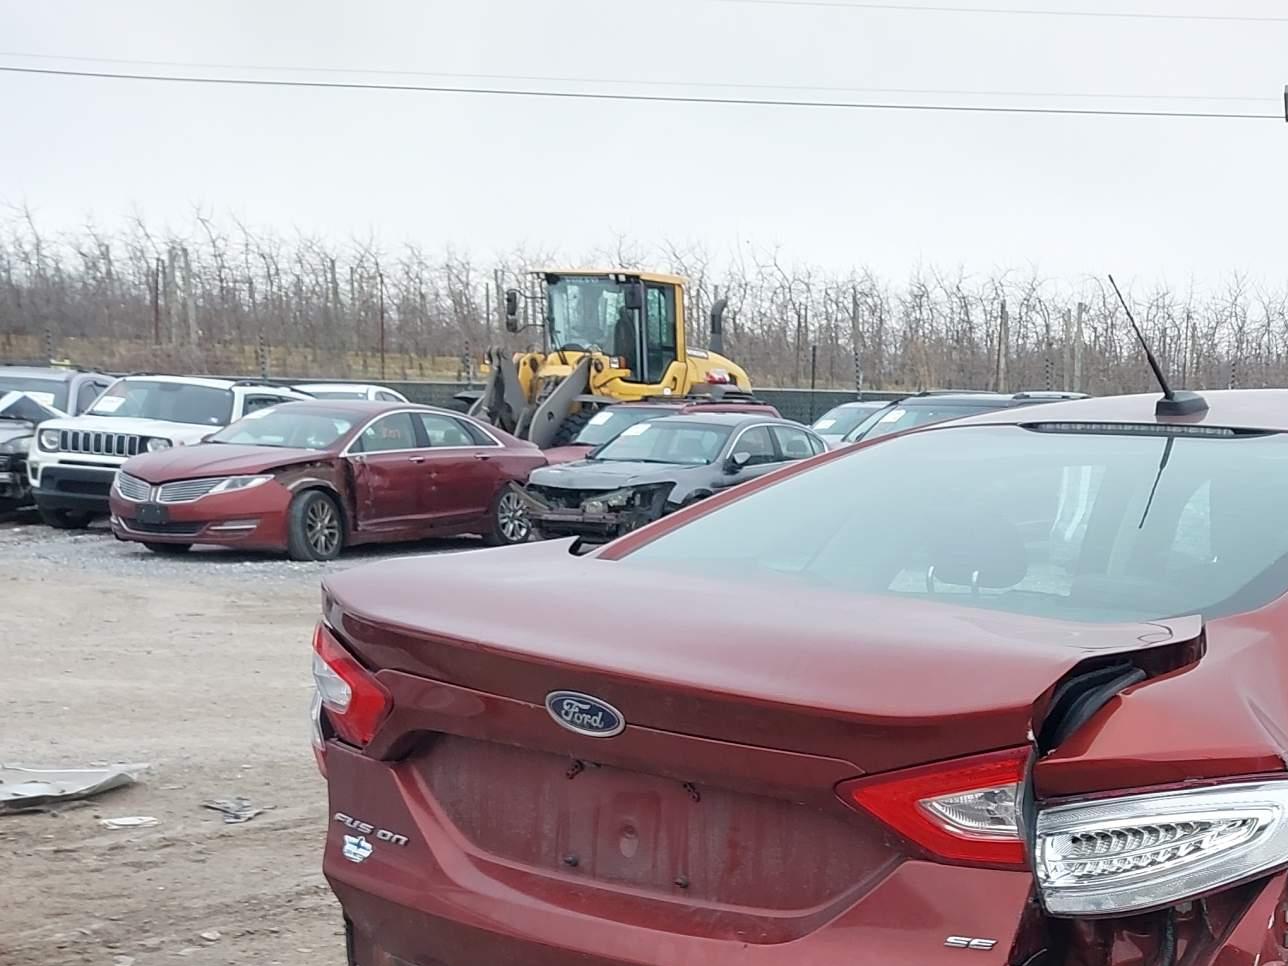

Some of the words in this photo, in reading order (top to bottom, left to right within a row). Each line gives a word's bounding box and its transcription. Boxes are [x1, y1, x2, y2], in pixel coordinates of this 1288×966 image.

[561, 699, 604, 729] Ford
[334, 812, 409, 846] FUSON
[944, 936, 998, 950] SE
